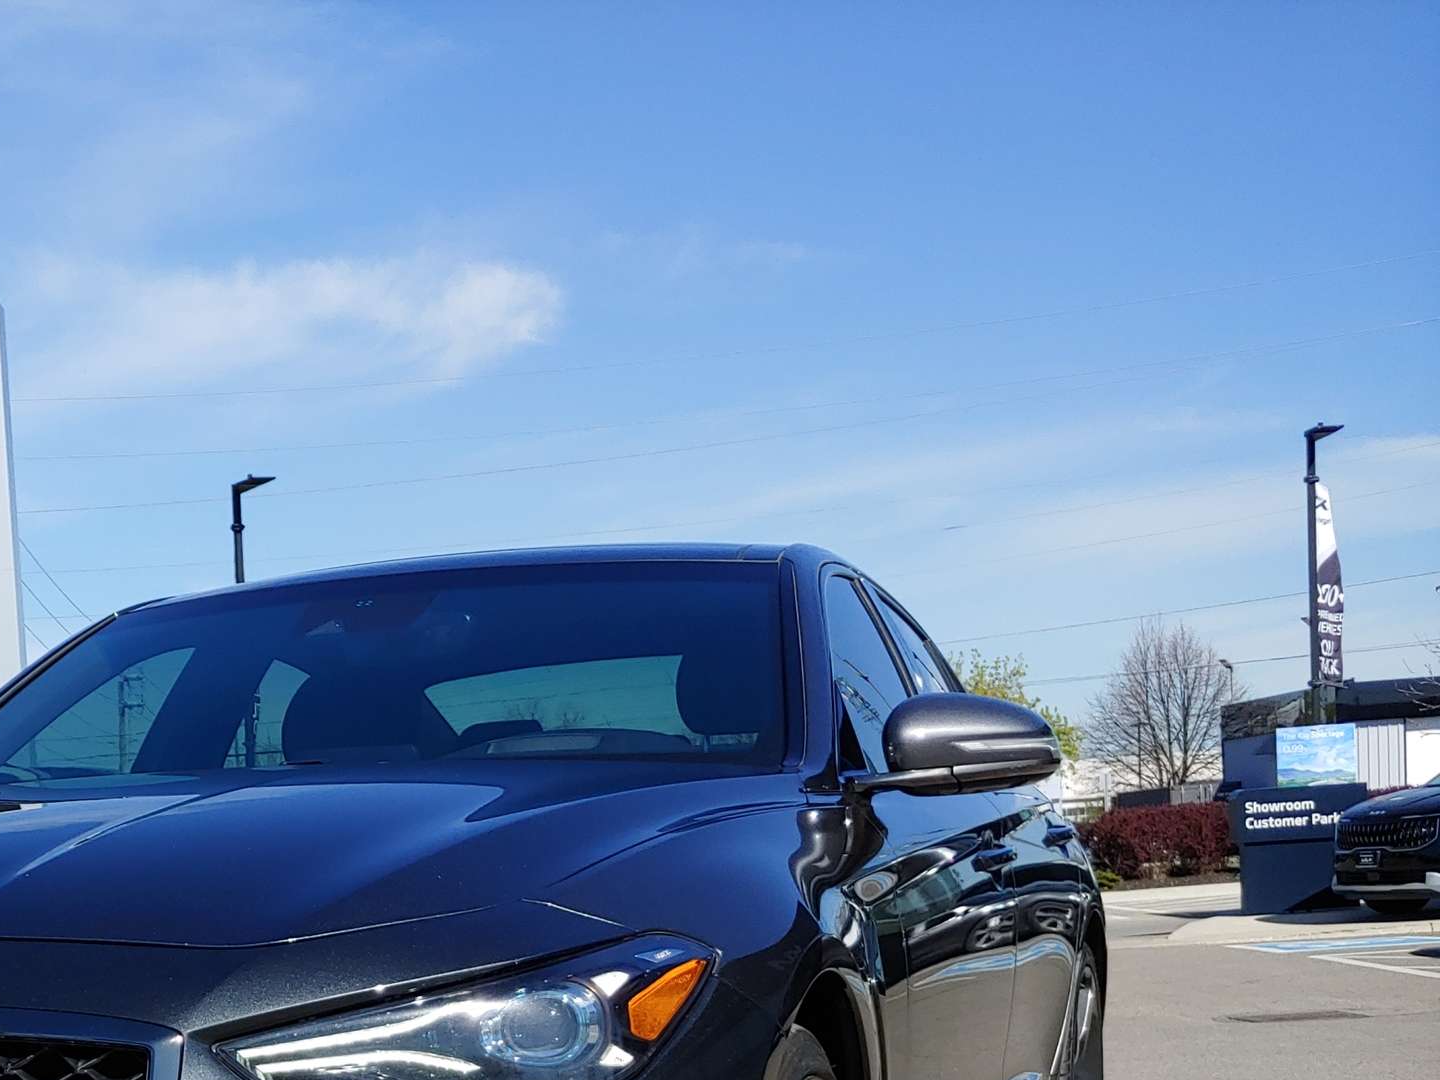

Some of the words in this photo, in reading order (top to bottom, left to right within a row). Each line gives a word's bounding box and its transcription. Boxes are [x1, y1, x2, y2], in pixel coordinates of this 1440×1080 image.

[1244, 800, 1315, 814] Showroom
[1245, 815, 1309, 829] Customer
[1311, 811, 1344, 825] Park
